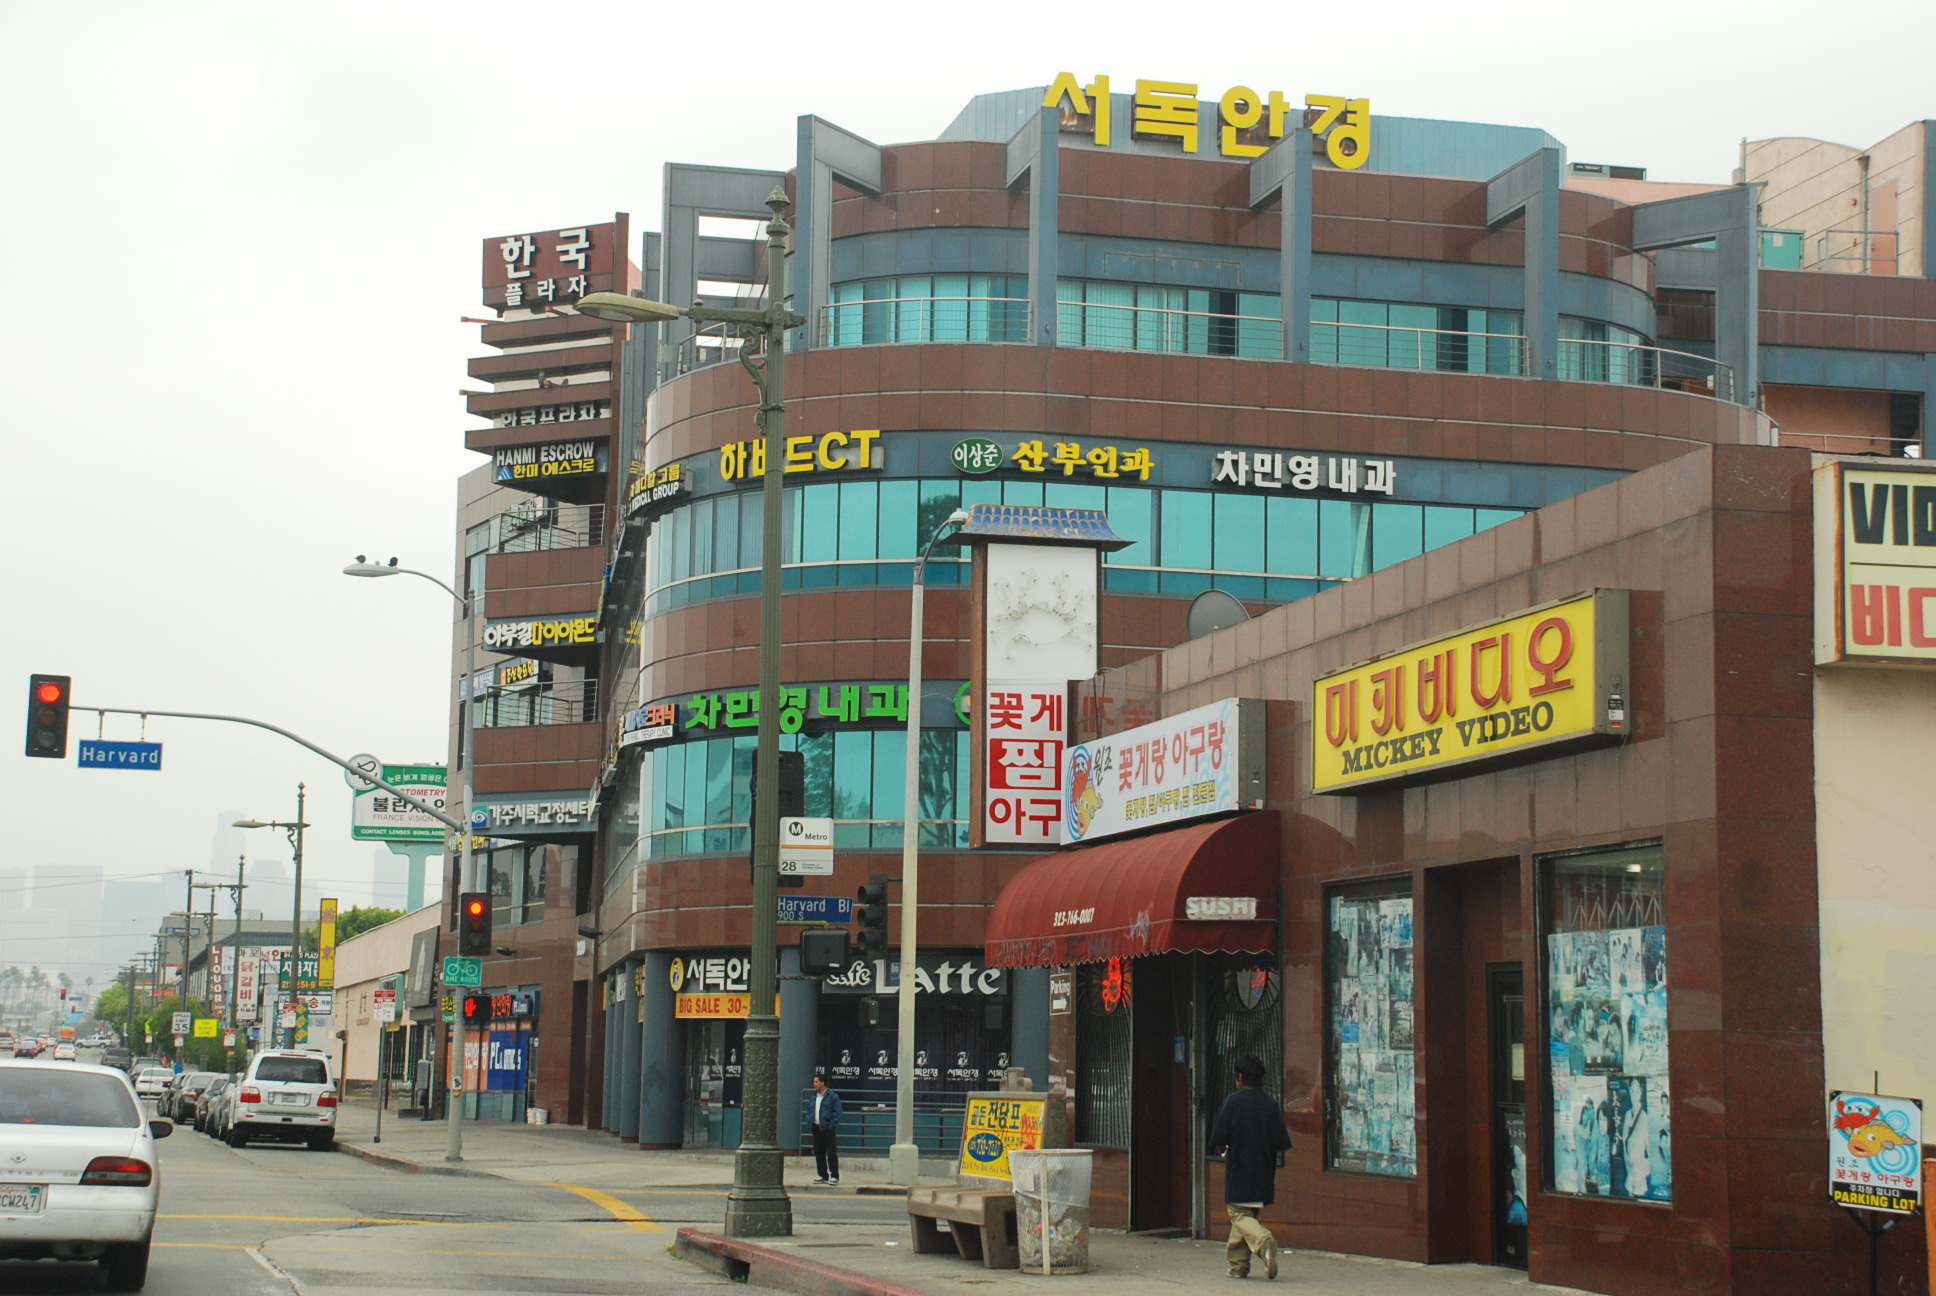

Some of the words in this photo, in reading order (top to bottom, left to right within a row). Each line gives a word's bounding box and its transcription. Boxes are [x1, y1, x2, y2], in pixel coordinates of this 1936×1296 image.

[1042, 71, 1370, 169] 서독안경
[500, 228, 590, 280] 한국
[504, 275, 587, 306] 플라자
[497, 447, 536, 467] HANMI
[541, 441, 594, 462] ESCROW
[954, 443, 998, 468] 이상준
[1011, 440, 1154, 481] 산부인과
[513, 464, 539, 479] 한미
[541, 458, 595, 476] 에스크로
[1216, 450, 1396, 495] 차민영내과
[652, 481, 680, 501] GROUP
[989, 692, 1062, 732] 꽃게
[1341, 727, 1443, 775] MICKEY
[1456, 701, 1554, 748] VIDEO
[82, 747, 159, 764] Harvard
[997, 741, 1057, 788] 찜
[401, 788, 446, 797] TOMETRY
[373, 813, 405, 822] FRANCE
[489, 801, 595, 826] 가주시력교정센터
[989, 797, 1061, 837] 아구
[804, 833, 828, 841] Metro
[781, 861, 797, 872] 28
[777, 897, 826, 912] Harvard
[838, 899, 850, 913] Bl
[1187, 897, 1257, 916] SUSHI
[777, 911, 795, 920] 900
[798, 911, 804, 920] S
[1053, 907, 1095, 927] 323-766-0007
[212, 945, 223, 1003] LIQUOR
[460, 976, 478, 984] ROUTE
[687, 958, 751, 991] 서독안
[1050, 979, 1071, 997] Parking
[679, 997, 692, 1014] BIG
[695, 997, 721, 1014] SALE
[727, 998, 751, 1014] 30~
[174, 1023, 189, 1032] 35
[831, 1066, 860, 1076] 서독안경
[914, 1068, 938, 1078] 독안경
[947, 1069, 979, 1079] 서독안경
[1835, 1168, 1871, 1183] 꽃게랑
[1877, 1173, 1915, 1188] 아구랑
[1849, 1184, 1873, 1194] 주차장
[0, 1194, 37, 1210] CW247
[1834, 1190, 1889, 1208] PARKING
[1892, 1197, 1917, 1211] LOT
